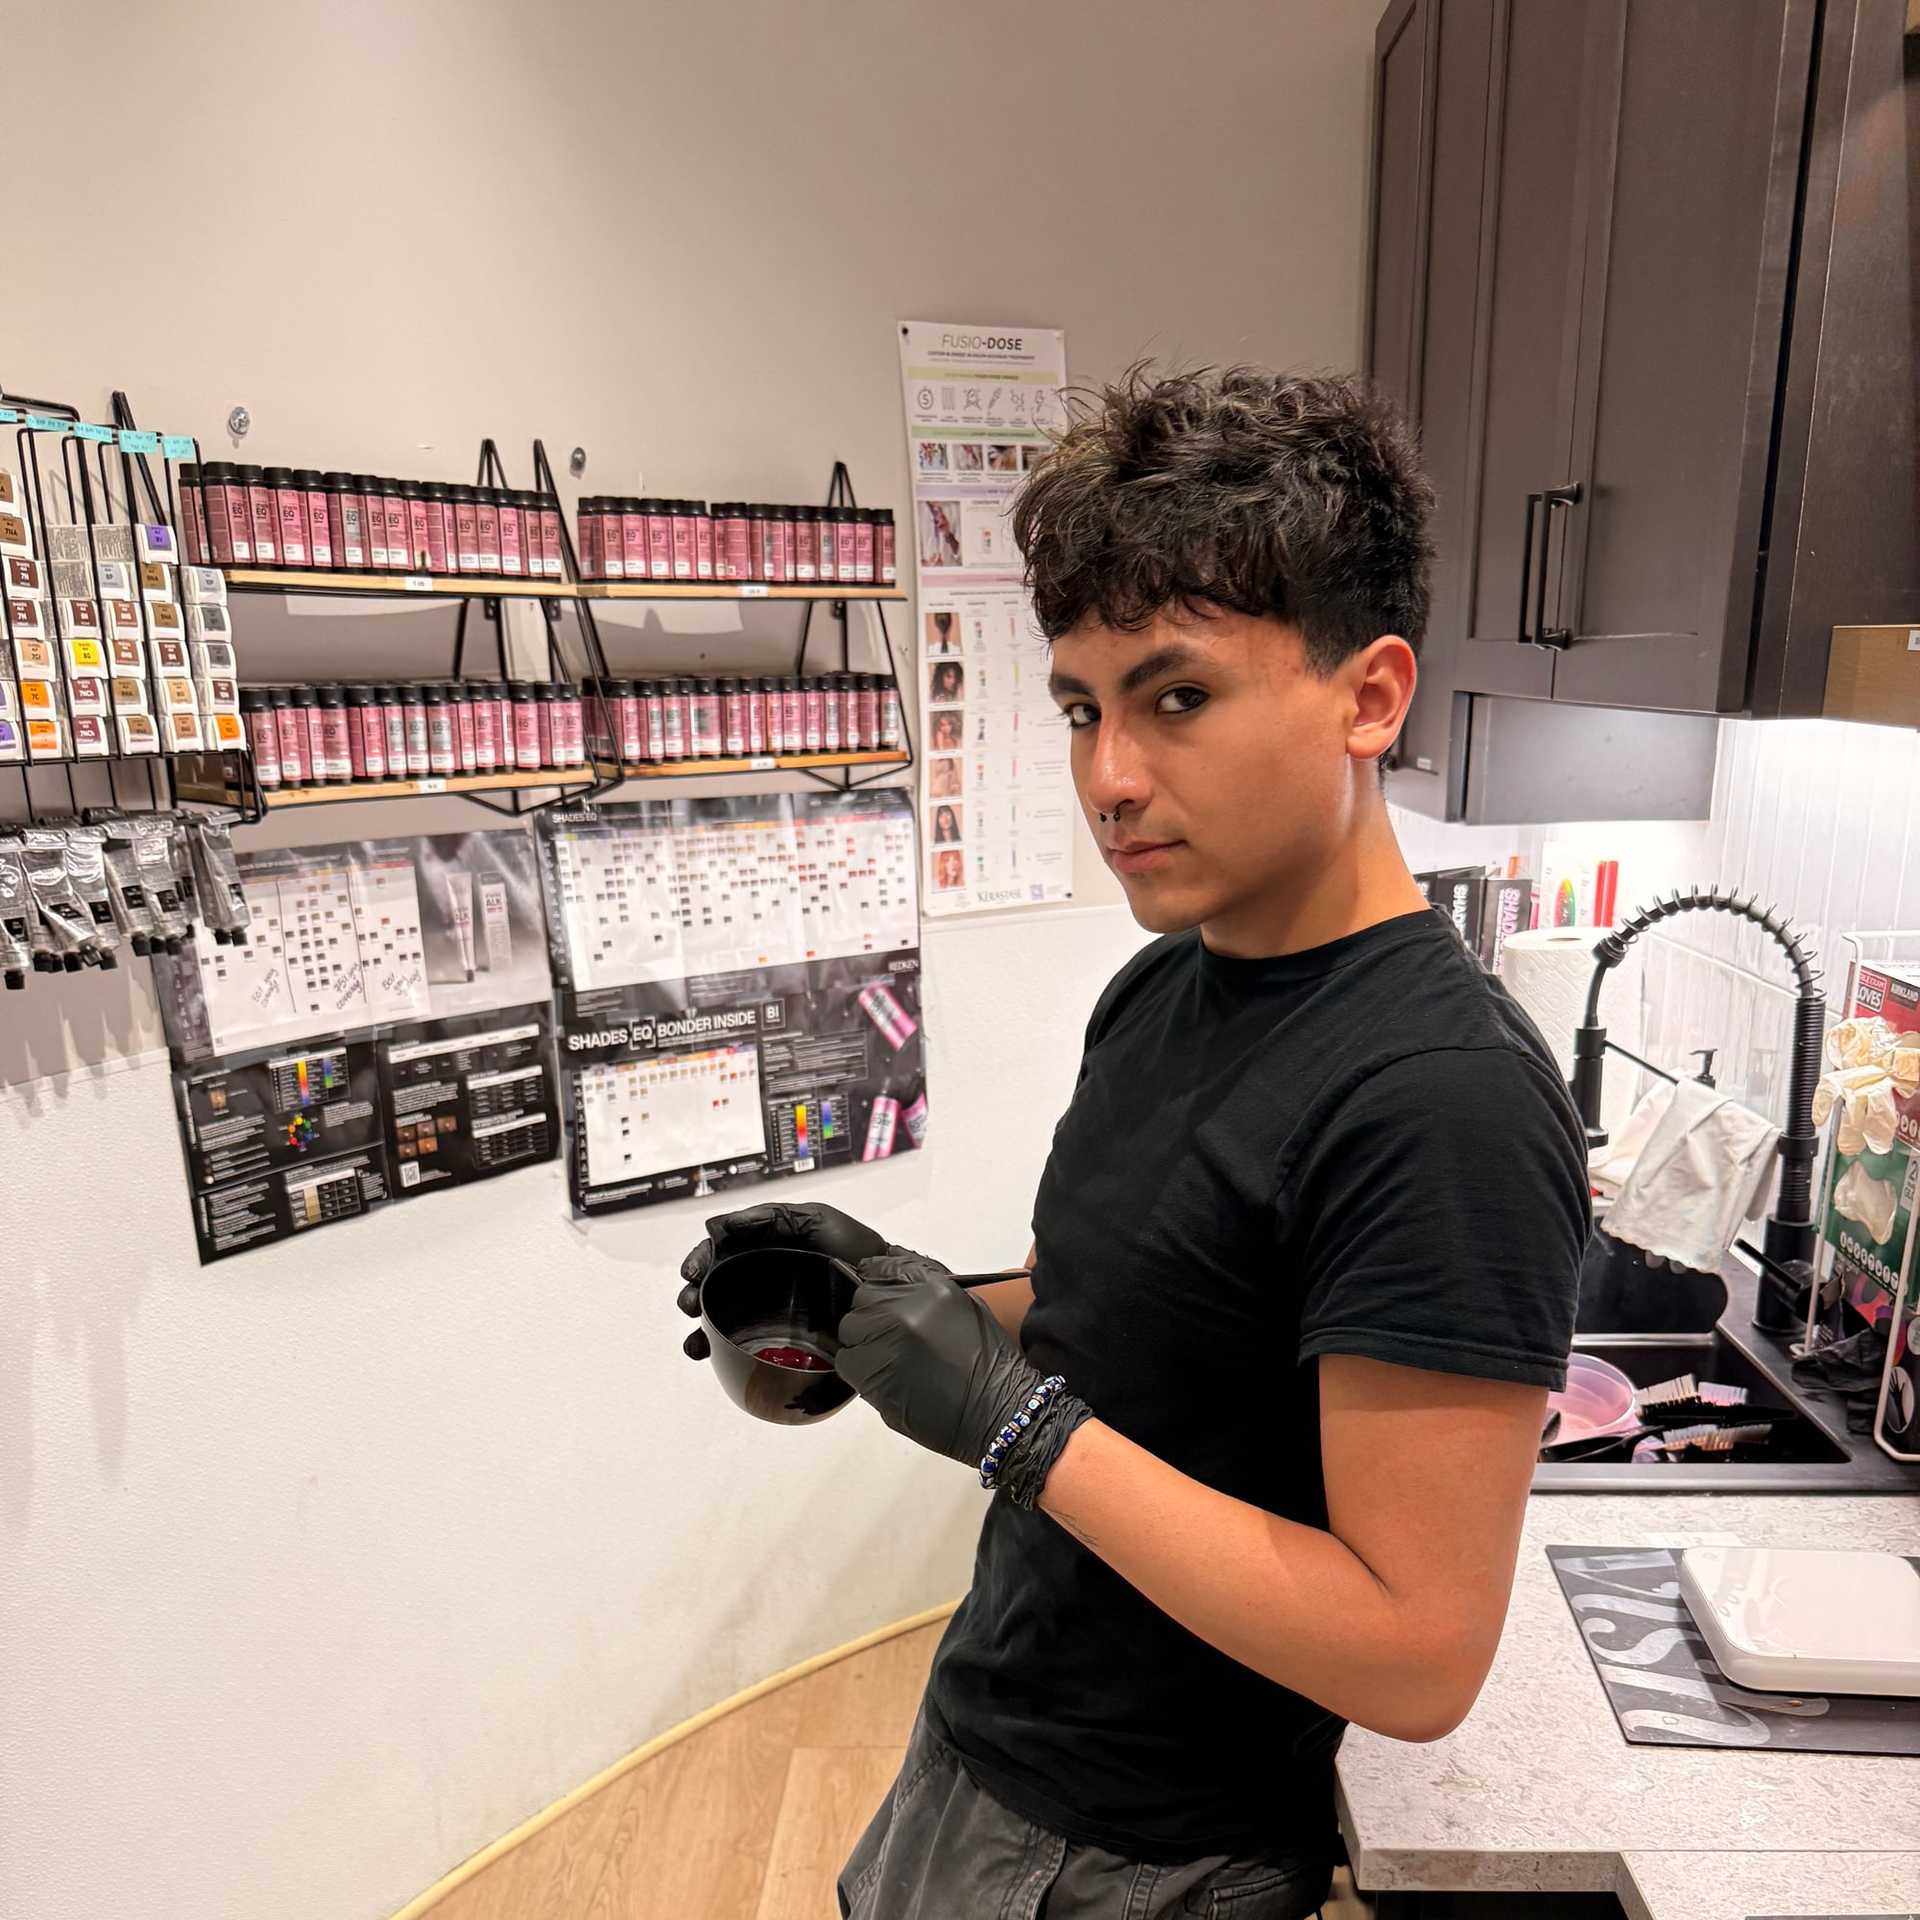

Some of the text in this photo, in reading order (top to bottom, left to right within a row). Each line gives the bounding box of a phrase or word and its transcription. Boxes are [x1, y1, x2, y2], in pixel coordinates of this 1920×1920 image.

[942, 334, 1022, 350] FUSIO-DOSE
[552, 812, 597, 824] SHADES EQ
[1453, 884, 1468, 936] SHAD
[888, 959, 919, 972] REDKEN
[1857, 983, 1881, 1009] LOVES
[765, 1005, 779, 1019] BI
[568, 1028, 628, 1051] SHADES
[632, 1025, 653, 1042] EQ
[656, 1017, 712, 1038] BONDER
[714, 1010, 756, 1029] INSIDE
